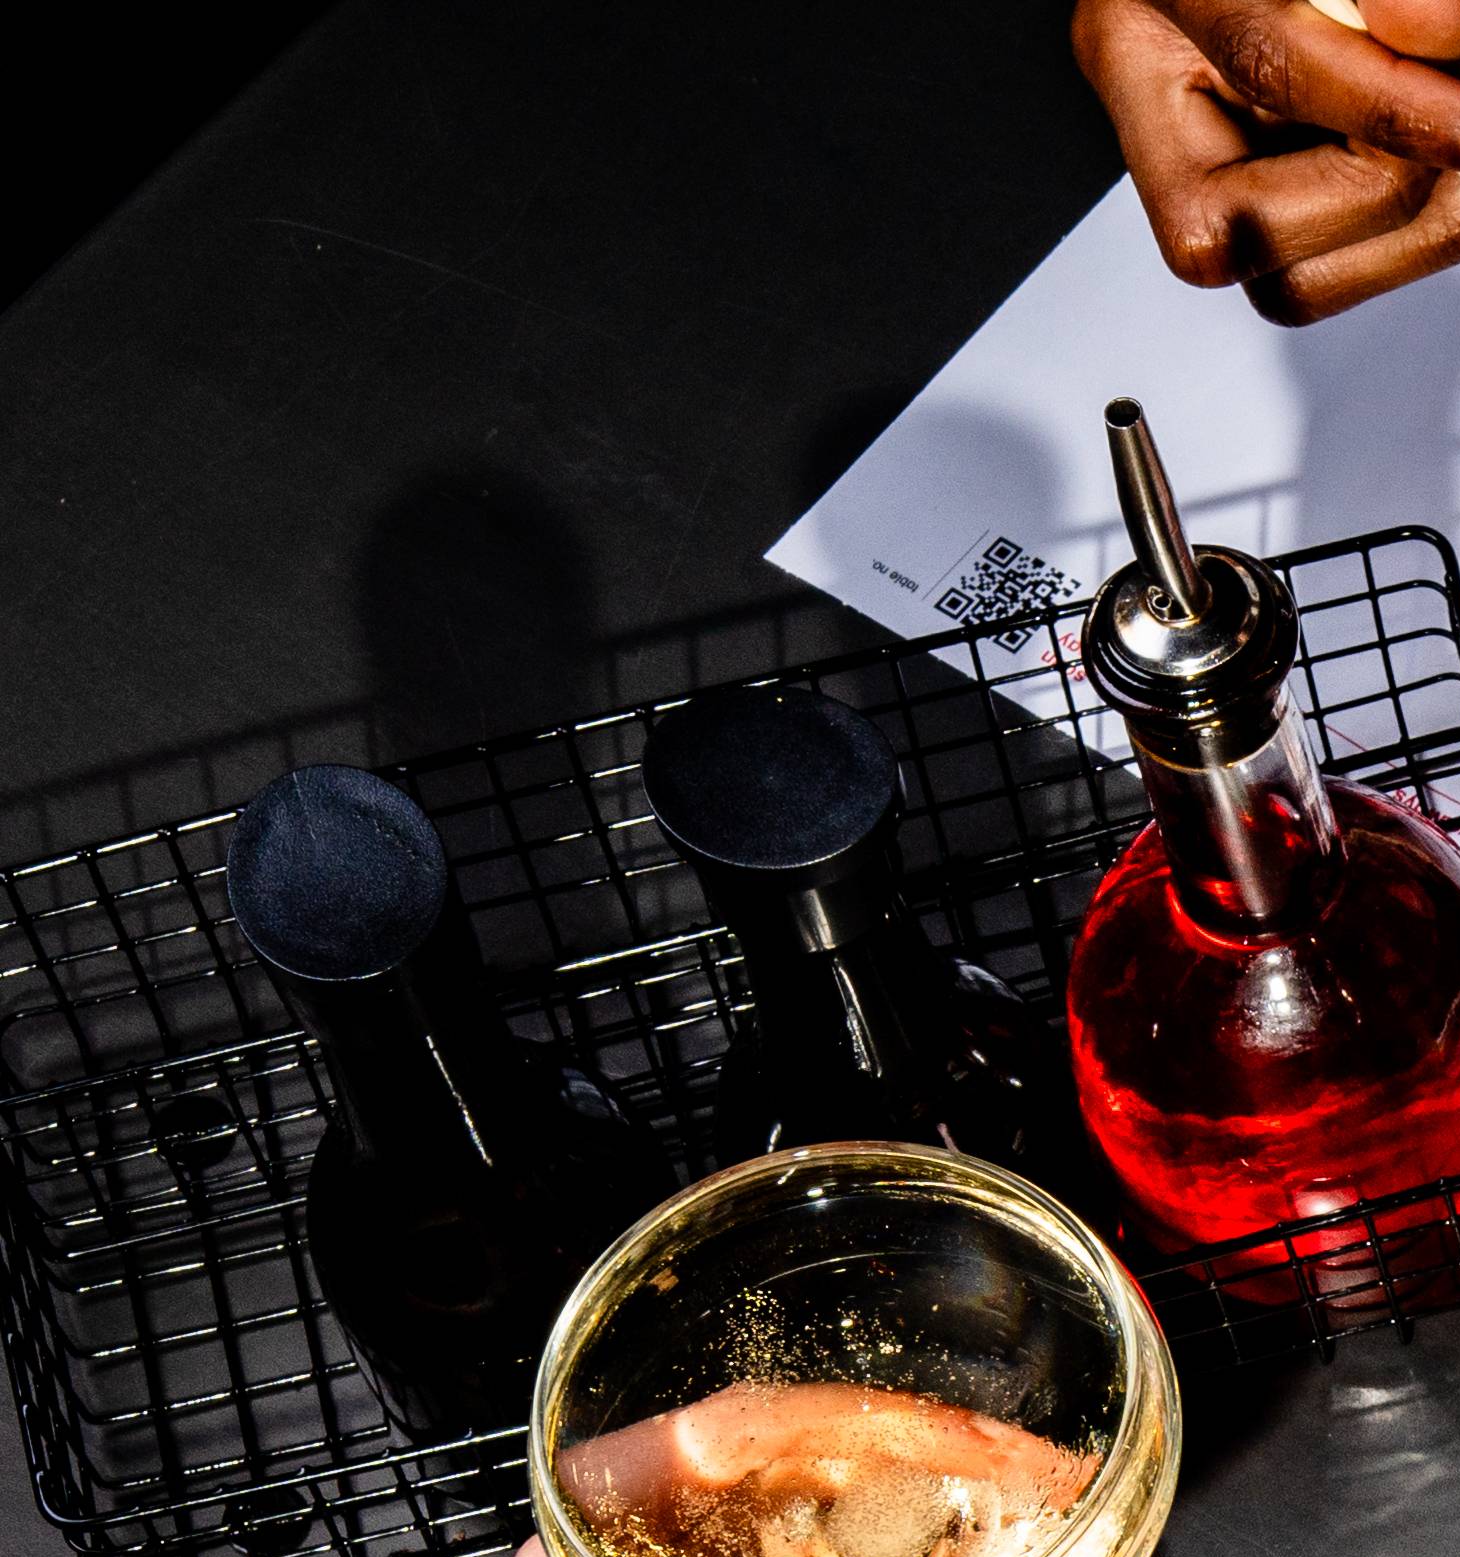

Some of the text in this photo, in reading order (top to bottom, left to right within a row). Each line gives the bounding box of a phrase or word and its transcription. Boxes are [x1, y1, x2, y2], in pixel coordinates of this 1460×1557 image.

[890, 569, 920, 594] table
[1058, 632, 1083, 655] ay
[1041, 650, 1087, 682] scn
